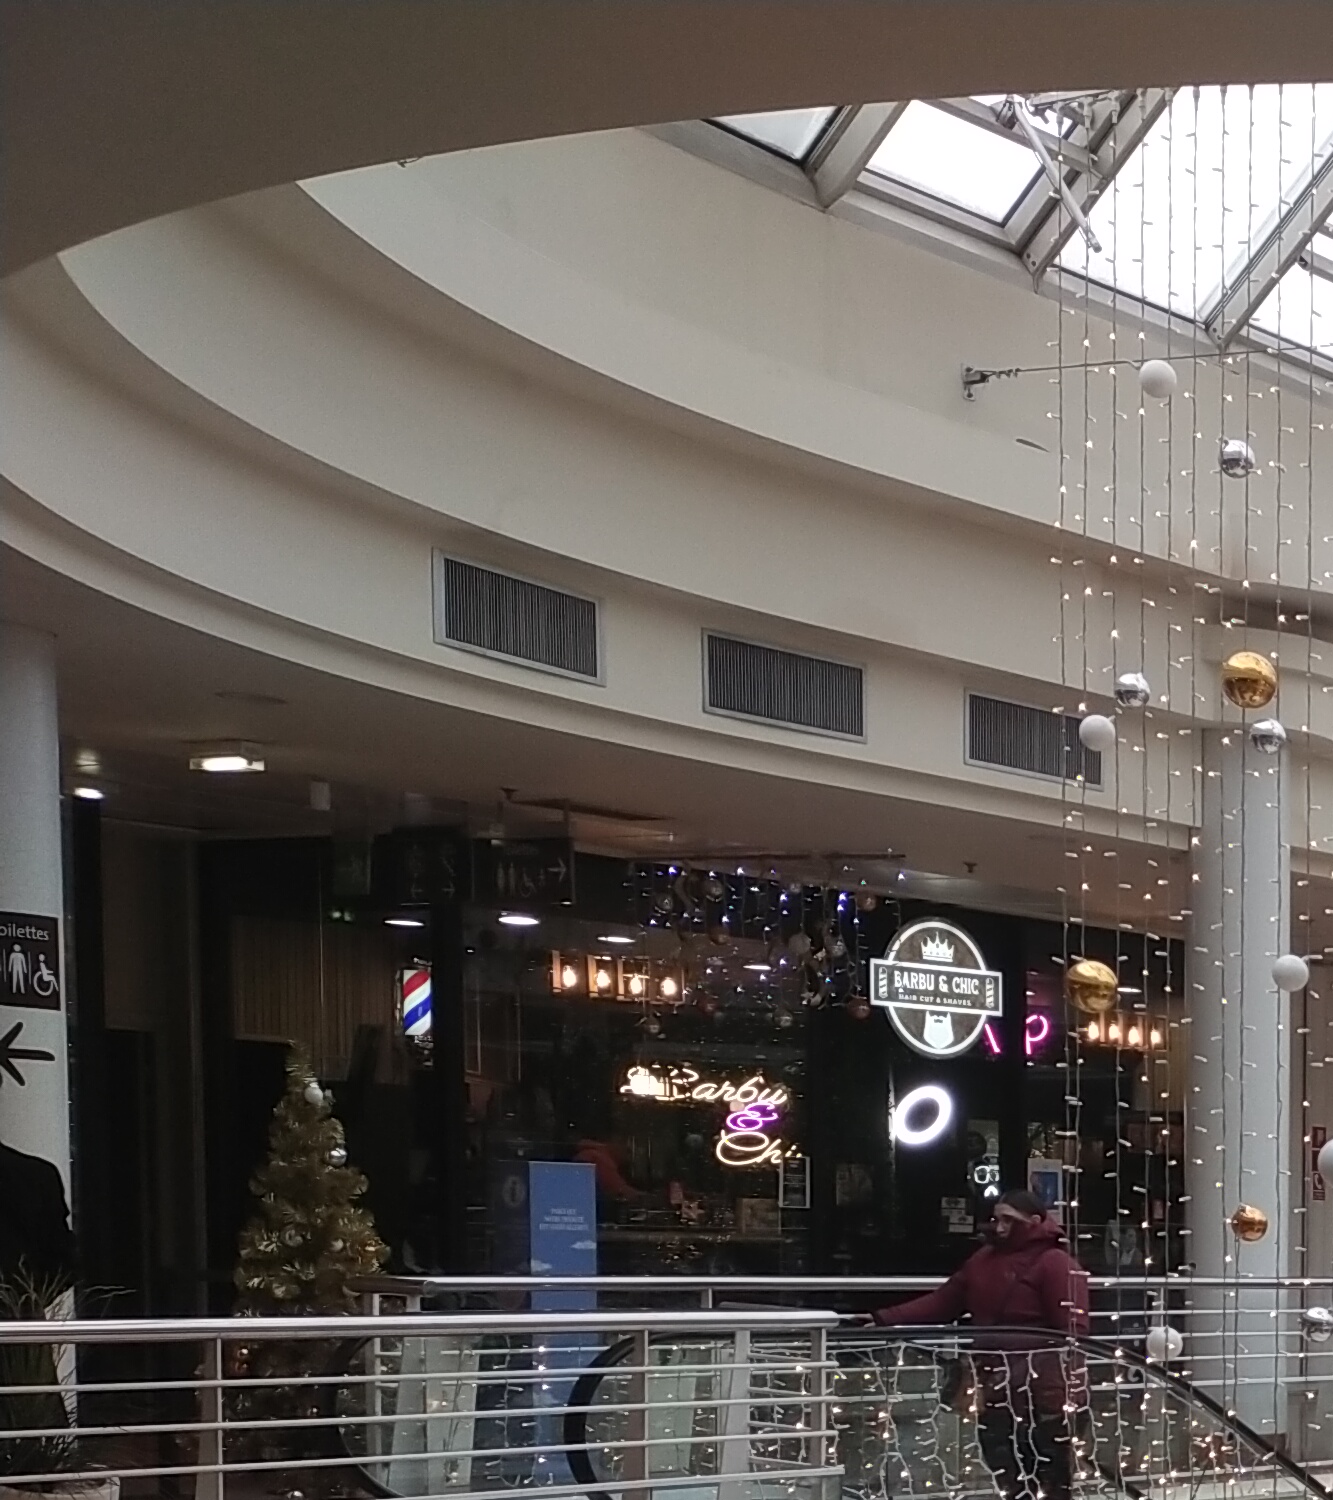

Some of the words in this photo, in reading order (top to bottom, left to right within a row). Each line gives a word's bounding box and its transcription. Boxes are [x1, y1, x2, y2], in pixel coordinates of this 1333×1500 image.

[894, 970, 935, 990] BARBU
[938, 975, 950, 993] &
[952, 977, 979, 995] CHIC
[898, 993, 917, 1001] HAIR
[919, 995, 934, 1003] CUT
[942, 997, 972, 1007] SHAVES
